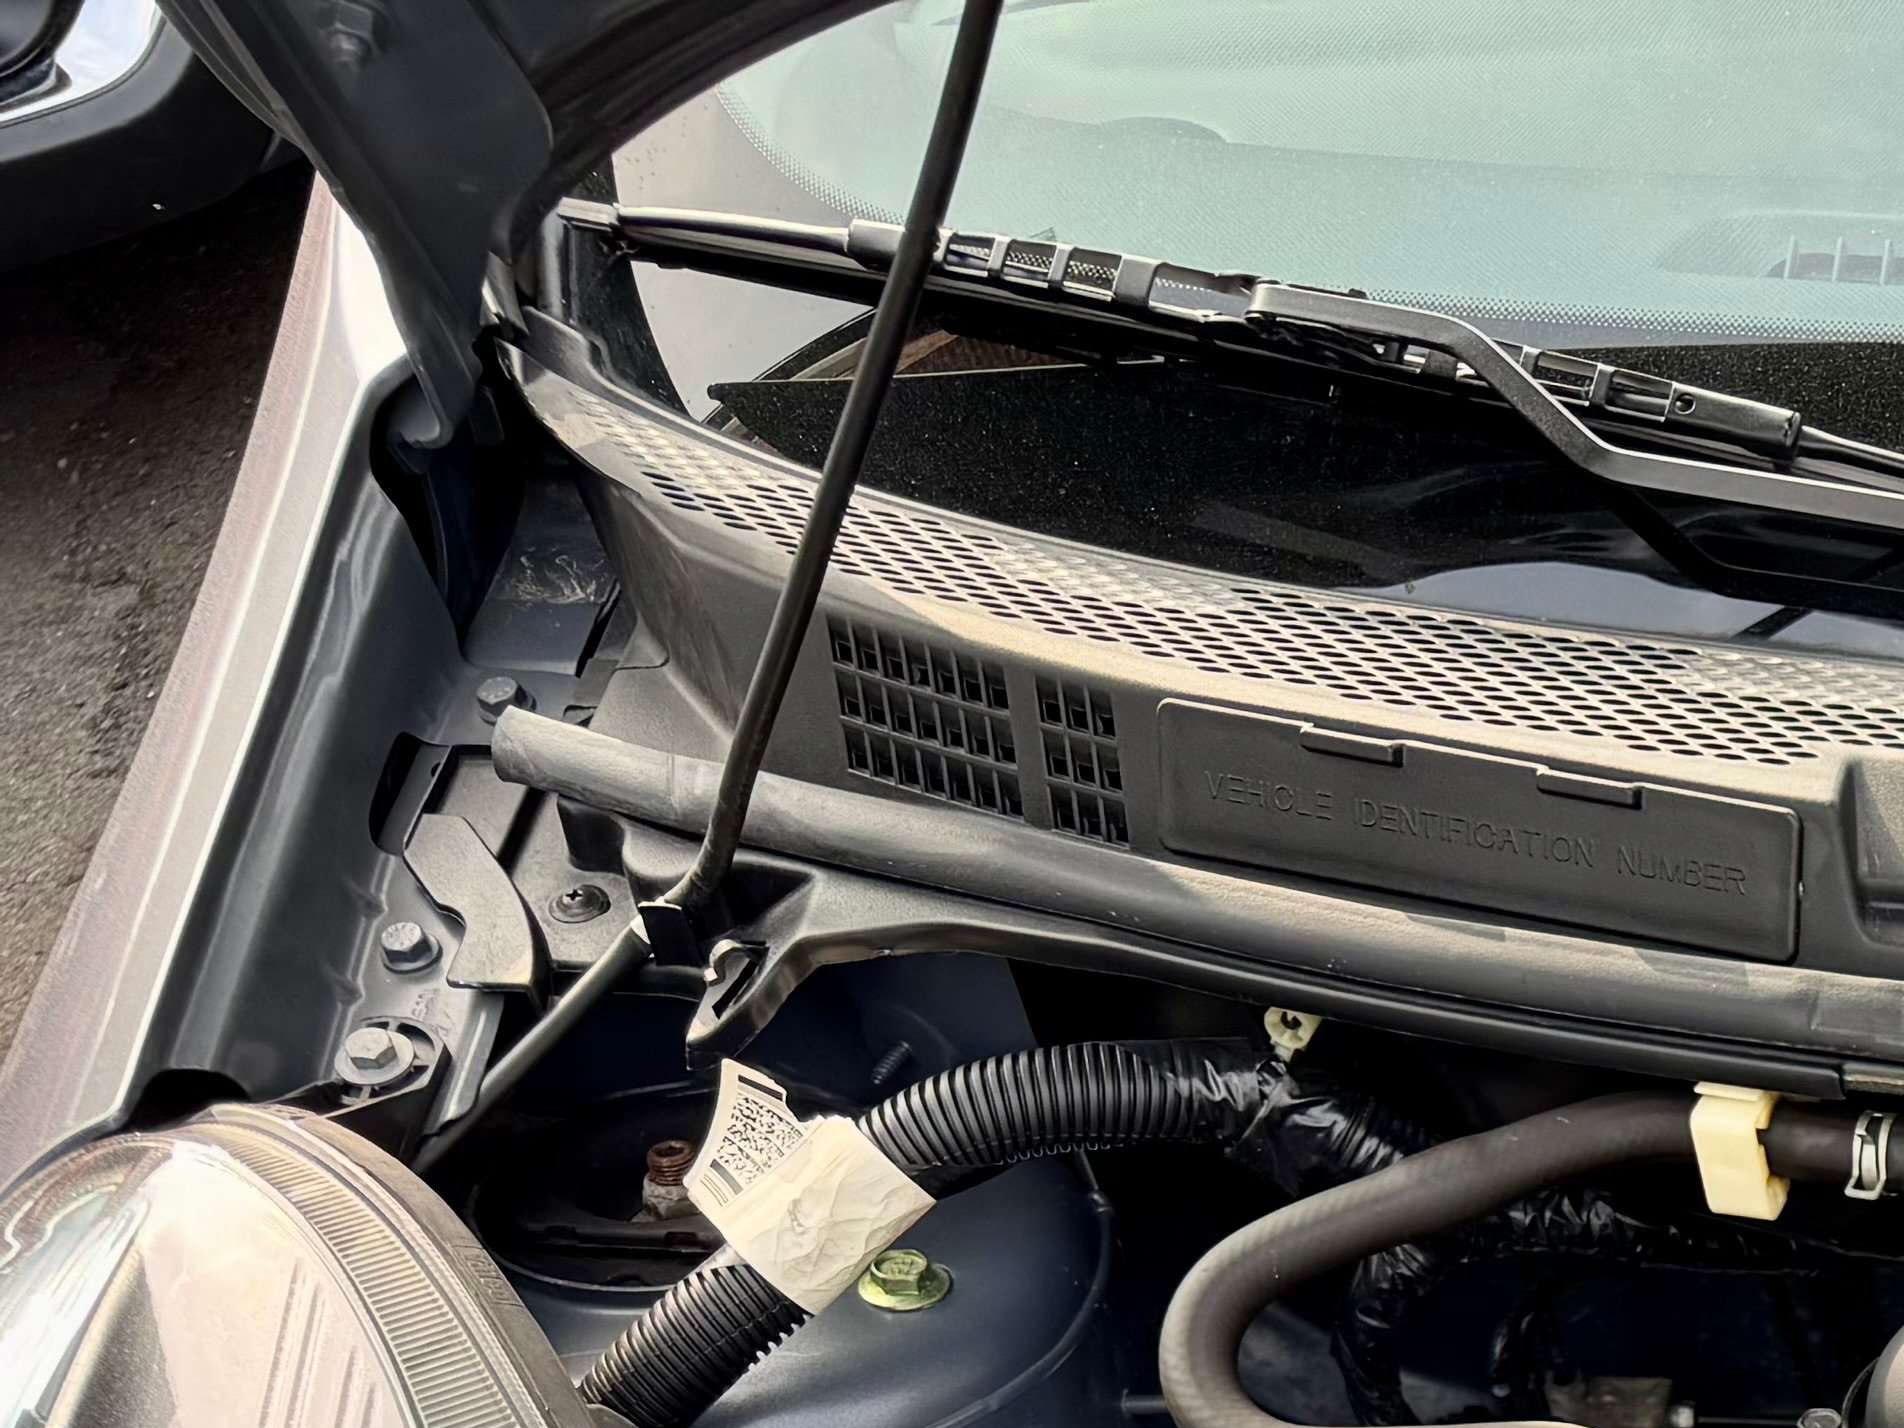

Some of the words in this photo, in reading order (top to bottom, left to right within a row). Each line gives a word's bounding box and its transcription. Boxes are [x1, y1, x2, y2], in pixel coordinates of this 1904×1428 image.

[1205, 770, 1333, 821] VEHICLE
[1353, 797, 1596, 868] IDENTIFICATION
[1616, 847, 1748, 896] NUMBER
